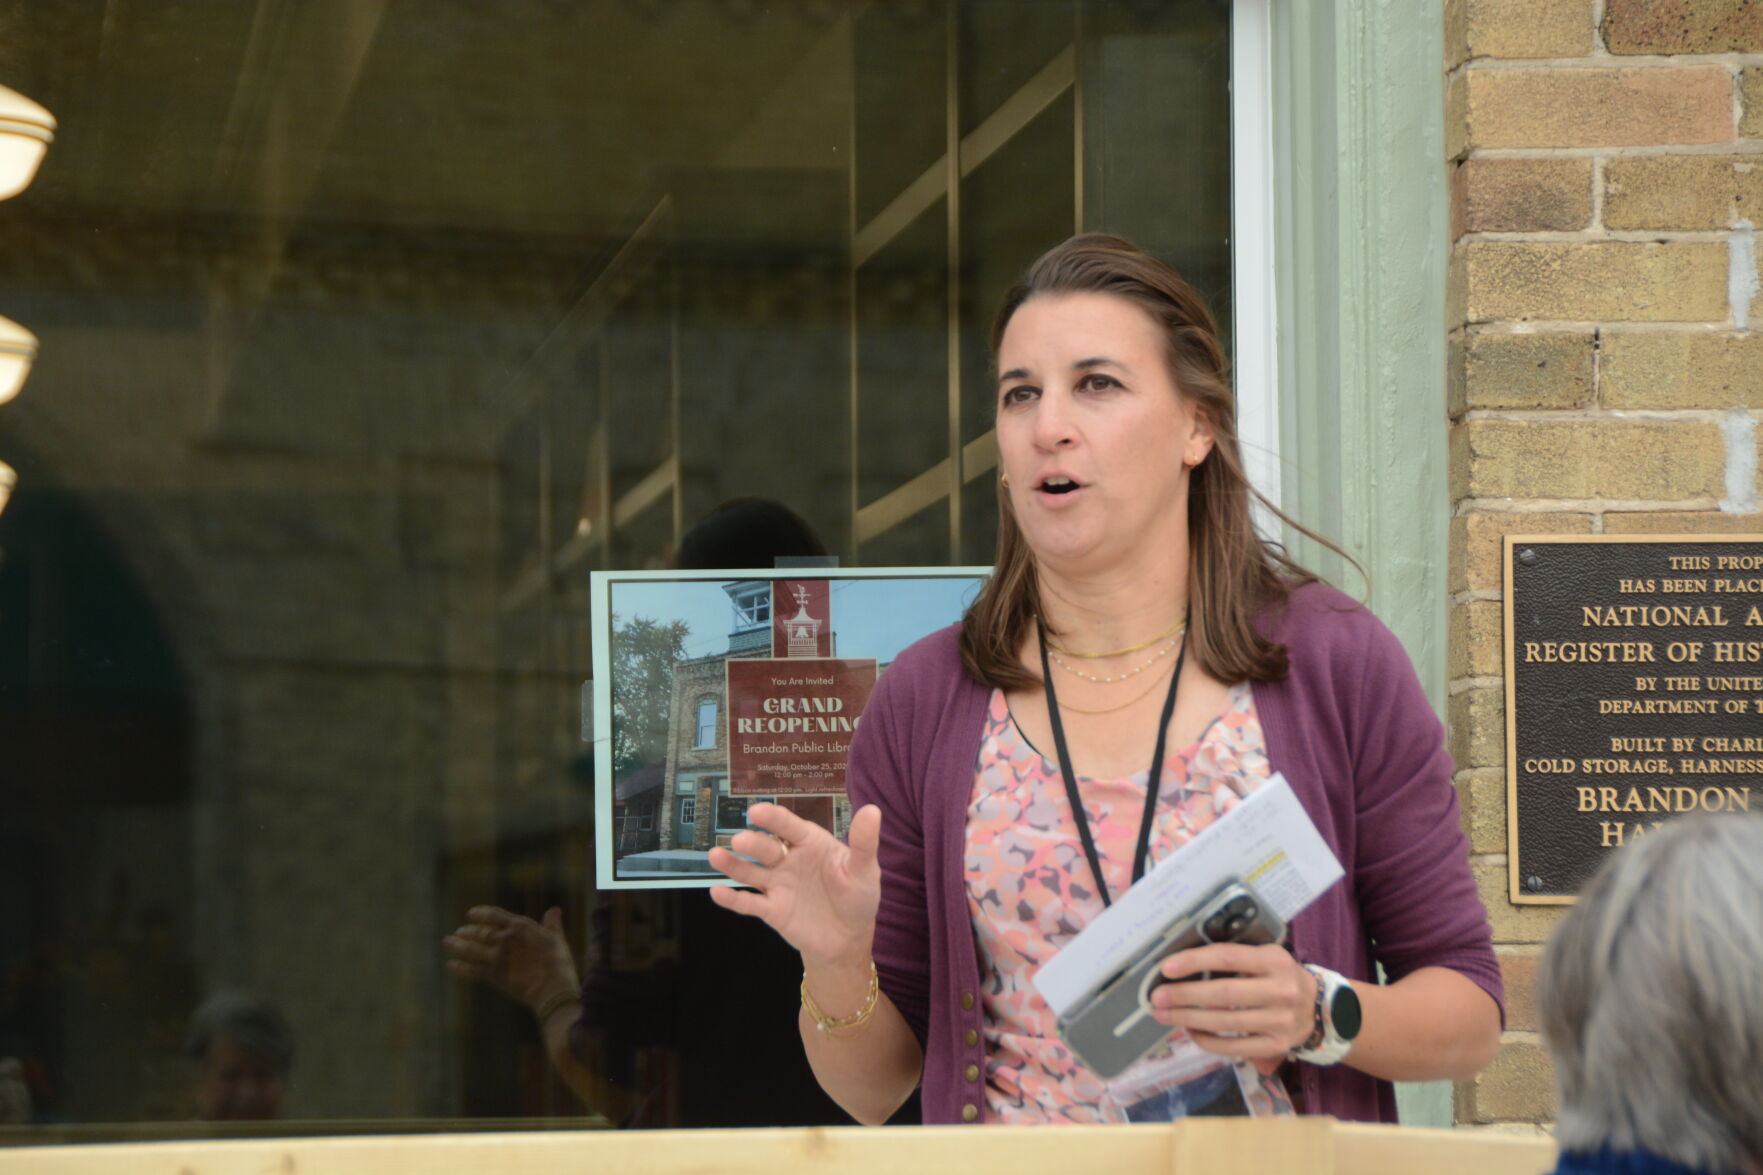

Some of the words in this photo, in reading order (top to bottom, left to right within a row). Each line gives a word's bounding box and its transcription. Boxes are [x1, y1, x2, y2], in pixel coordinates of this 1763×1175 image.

[1669, 556, 1710, 570] THIS
[1717, 556, 1763, 570] PROP
[1619, 579, 1655, 593] HAS
[1662, 579, 1707, 593] BEEN
[1582, 606, 1729, 626] NATIONAL
[1744, 606, 1763, 626] A
[1524, 642, 1656, 662] REGISTER
[1667, 642, 1704, 662] OF
[1712, 642, 1763, 662] HIS
[771, 677, 787, 686] You
[789, 677, 803, 685] Are
[806, 675, 834, 685] Invited
[1635, 677, 1658, 691] BY
[1664, 677, 1701, 691] THE
[1706, 677, 1763, 691] UNITE
[763, 697, 843, 714] GRAND
[1600, 700, 1719, 714] DEPARTMENT
[1725, 700, 1749, 714] OF
[743, 741, 789, 754] Brandon
[792, 741, 824, 753] Public
[1611, 738, 1666, 752] BUILT
[1672, 738, 1695, 752] BY
[757, 763, 790, 773] Saturday,
[791, 762, 819, 771] October
[1525, 759, 1576, 774] COLD
[1582, 759, 1674, 775] STORAGE,
[1681, 759, 1763, 773] HARNESS
[1576, 786, 1750, 812] BRANDON
